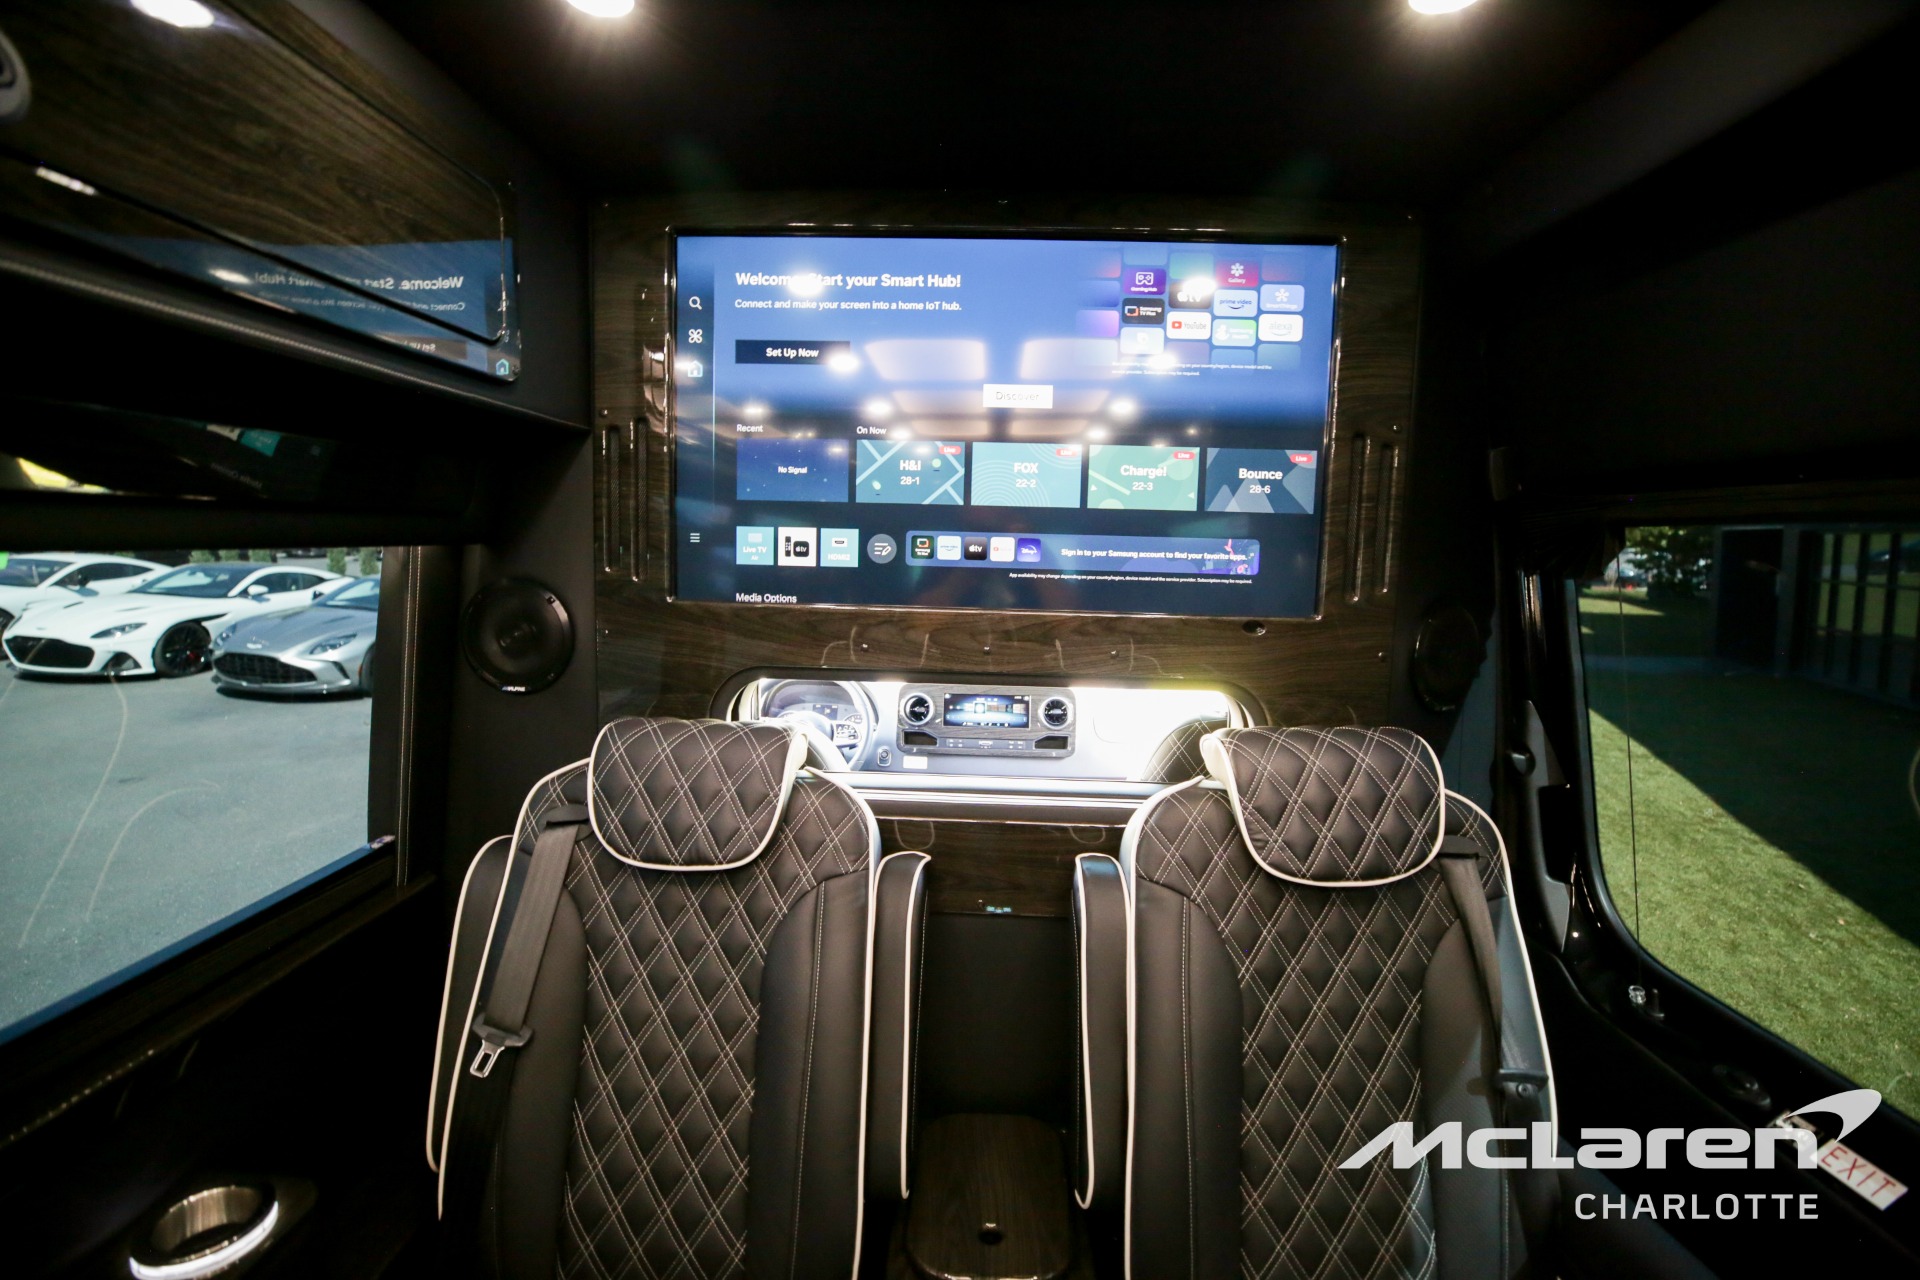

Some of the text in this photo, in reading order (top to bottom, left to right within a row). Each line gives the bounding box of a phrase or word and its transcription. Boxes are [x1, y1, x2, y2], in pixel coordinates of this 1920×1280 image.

[846, 275, 878, 289] your
[881, 274, 924, 287] Smart
[927, 274, 961, 287] Hub!
[734, 299, 962, 311] Connect and make your screen into a home IoT hub.
[766, 347, 819, 359] Set Up Now
[995, 391, 1040, 401] Discover
[736, 424, 763, 433] Recent
[856, 426, 887, 435] On Now
[778, 466, 807, 475] No Signal
[1013, 462, 1038, 474] FOX
[1120, 465, 1167, 479] Charge!
[1238, 468, 1283, 480] Bounce
[900, 476, 920, 486] 28-1
[1015, 479, 1037, 488] 22-2
[1132, 481, 1153, 491] 22-3
[1249, 484, 1271, 494] 28-6
[1061, 548, 1076, 557] Sign
[1108, 550, 1138, 558] Samsung
[1174, 551, 1187, 559] find
[1203, 552, 1229, 560] favorite
[735, 593, 798, 604] Media Options
[1820, 1145, 1897, 1198] EXIT
